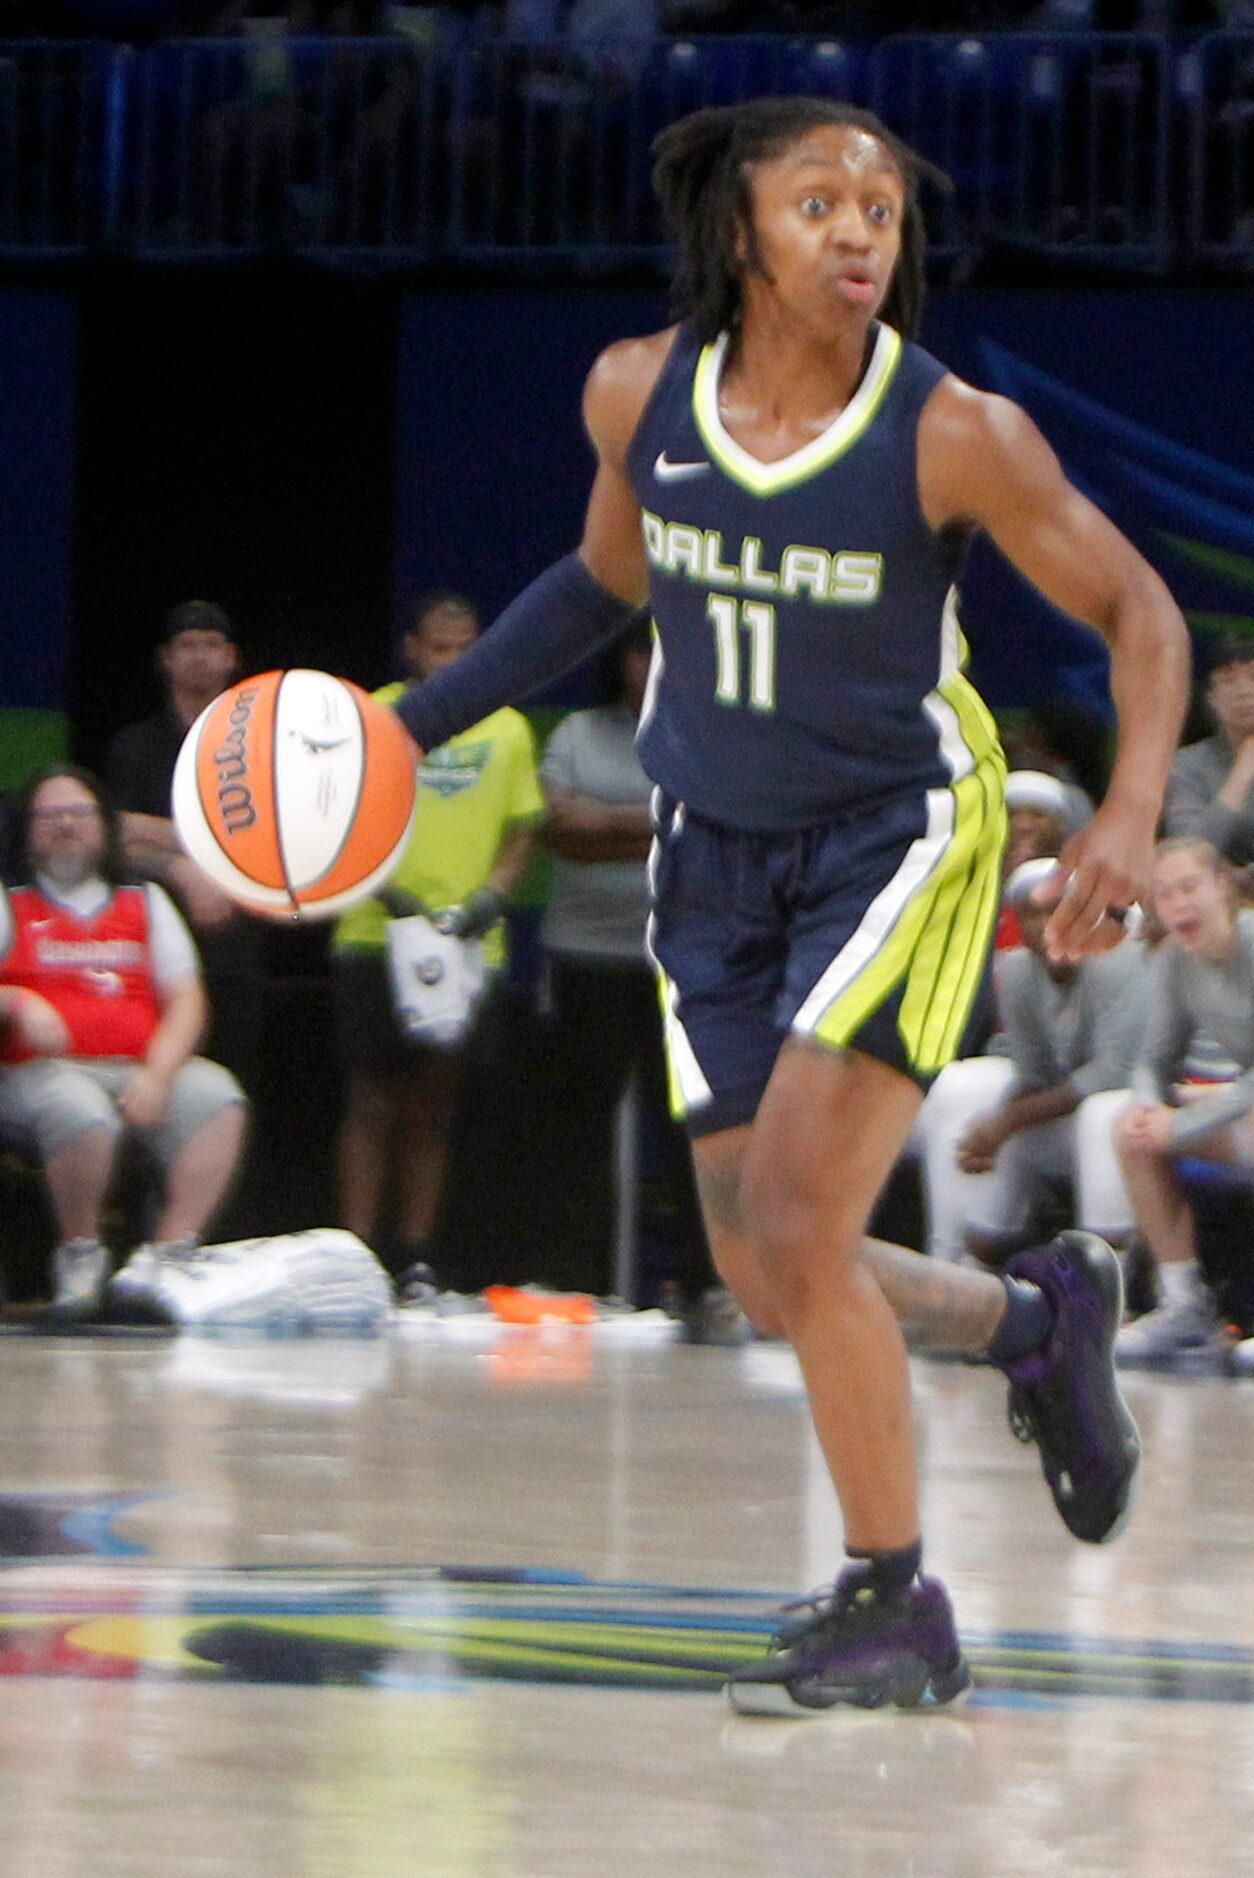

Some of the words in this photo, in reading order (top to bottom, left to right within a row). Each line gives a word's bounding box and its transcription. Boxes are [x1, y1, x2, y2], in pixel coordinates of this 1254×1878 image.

[641, 507, 885, 604] DALLAS
[708, 592, 777, 711] 11
[214, 685, 260, 836] Wilson
